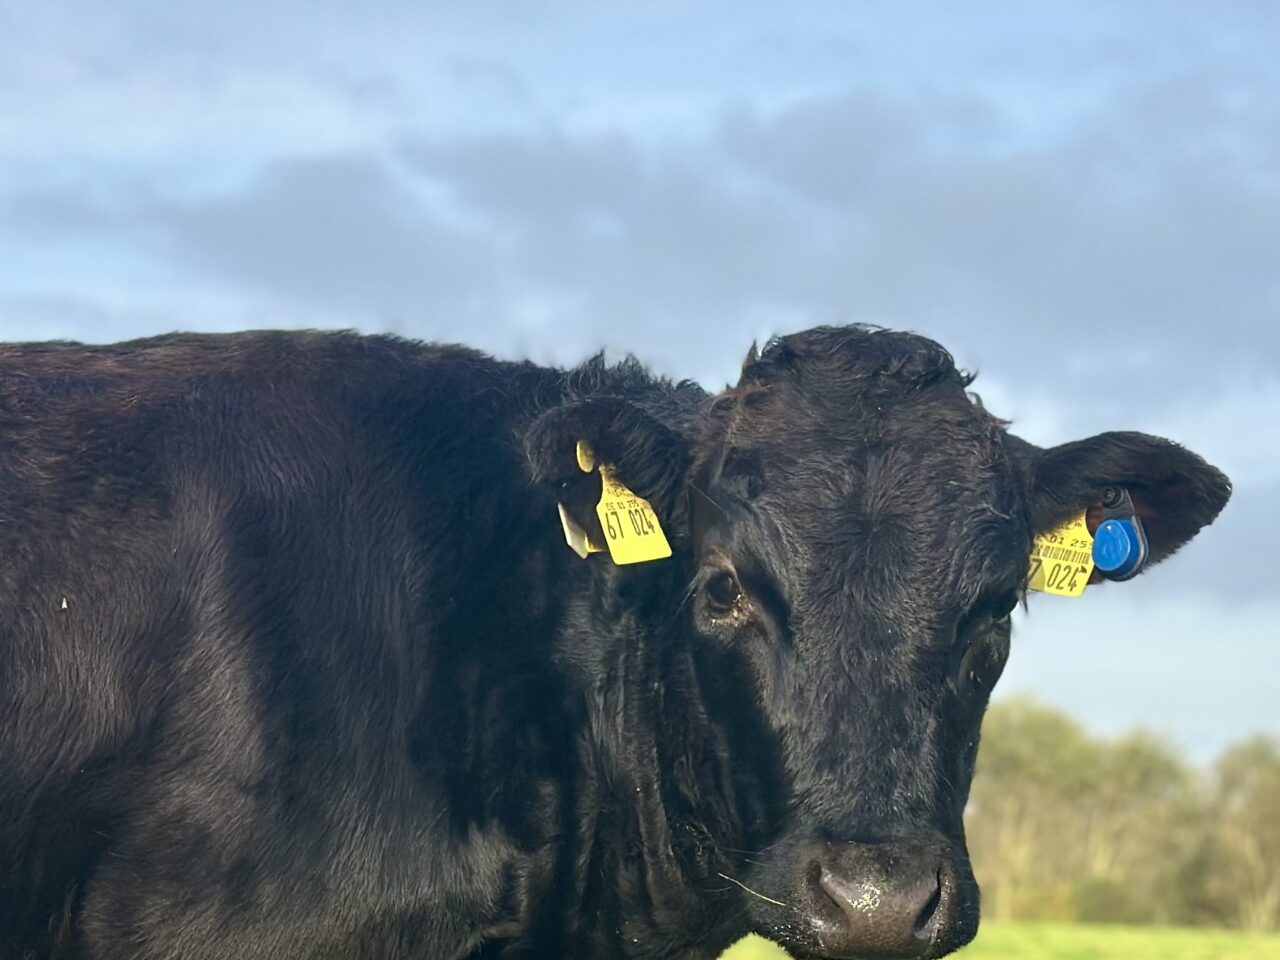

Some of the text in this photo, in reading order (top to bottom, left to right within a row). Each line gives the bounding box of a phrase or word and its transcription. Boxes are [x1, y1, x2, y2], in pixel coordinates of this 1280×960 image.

[605, 508, 655, 540] 67 024
[1050, 535, 1093, 549] 01 25
[1047, 563, 1078, 592] 024
